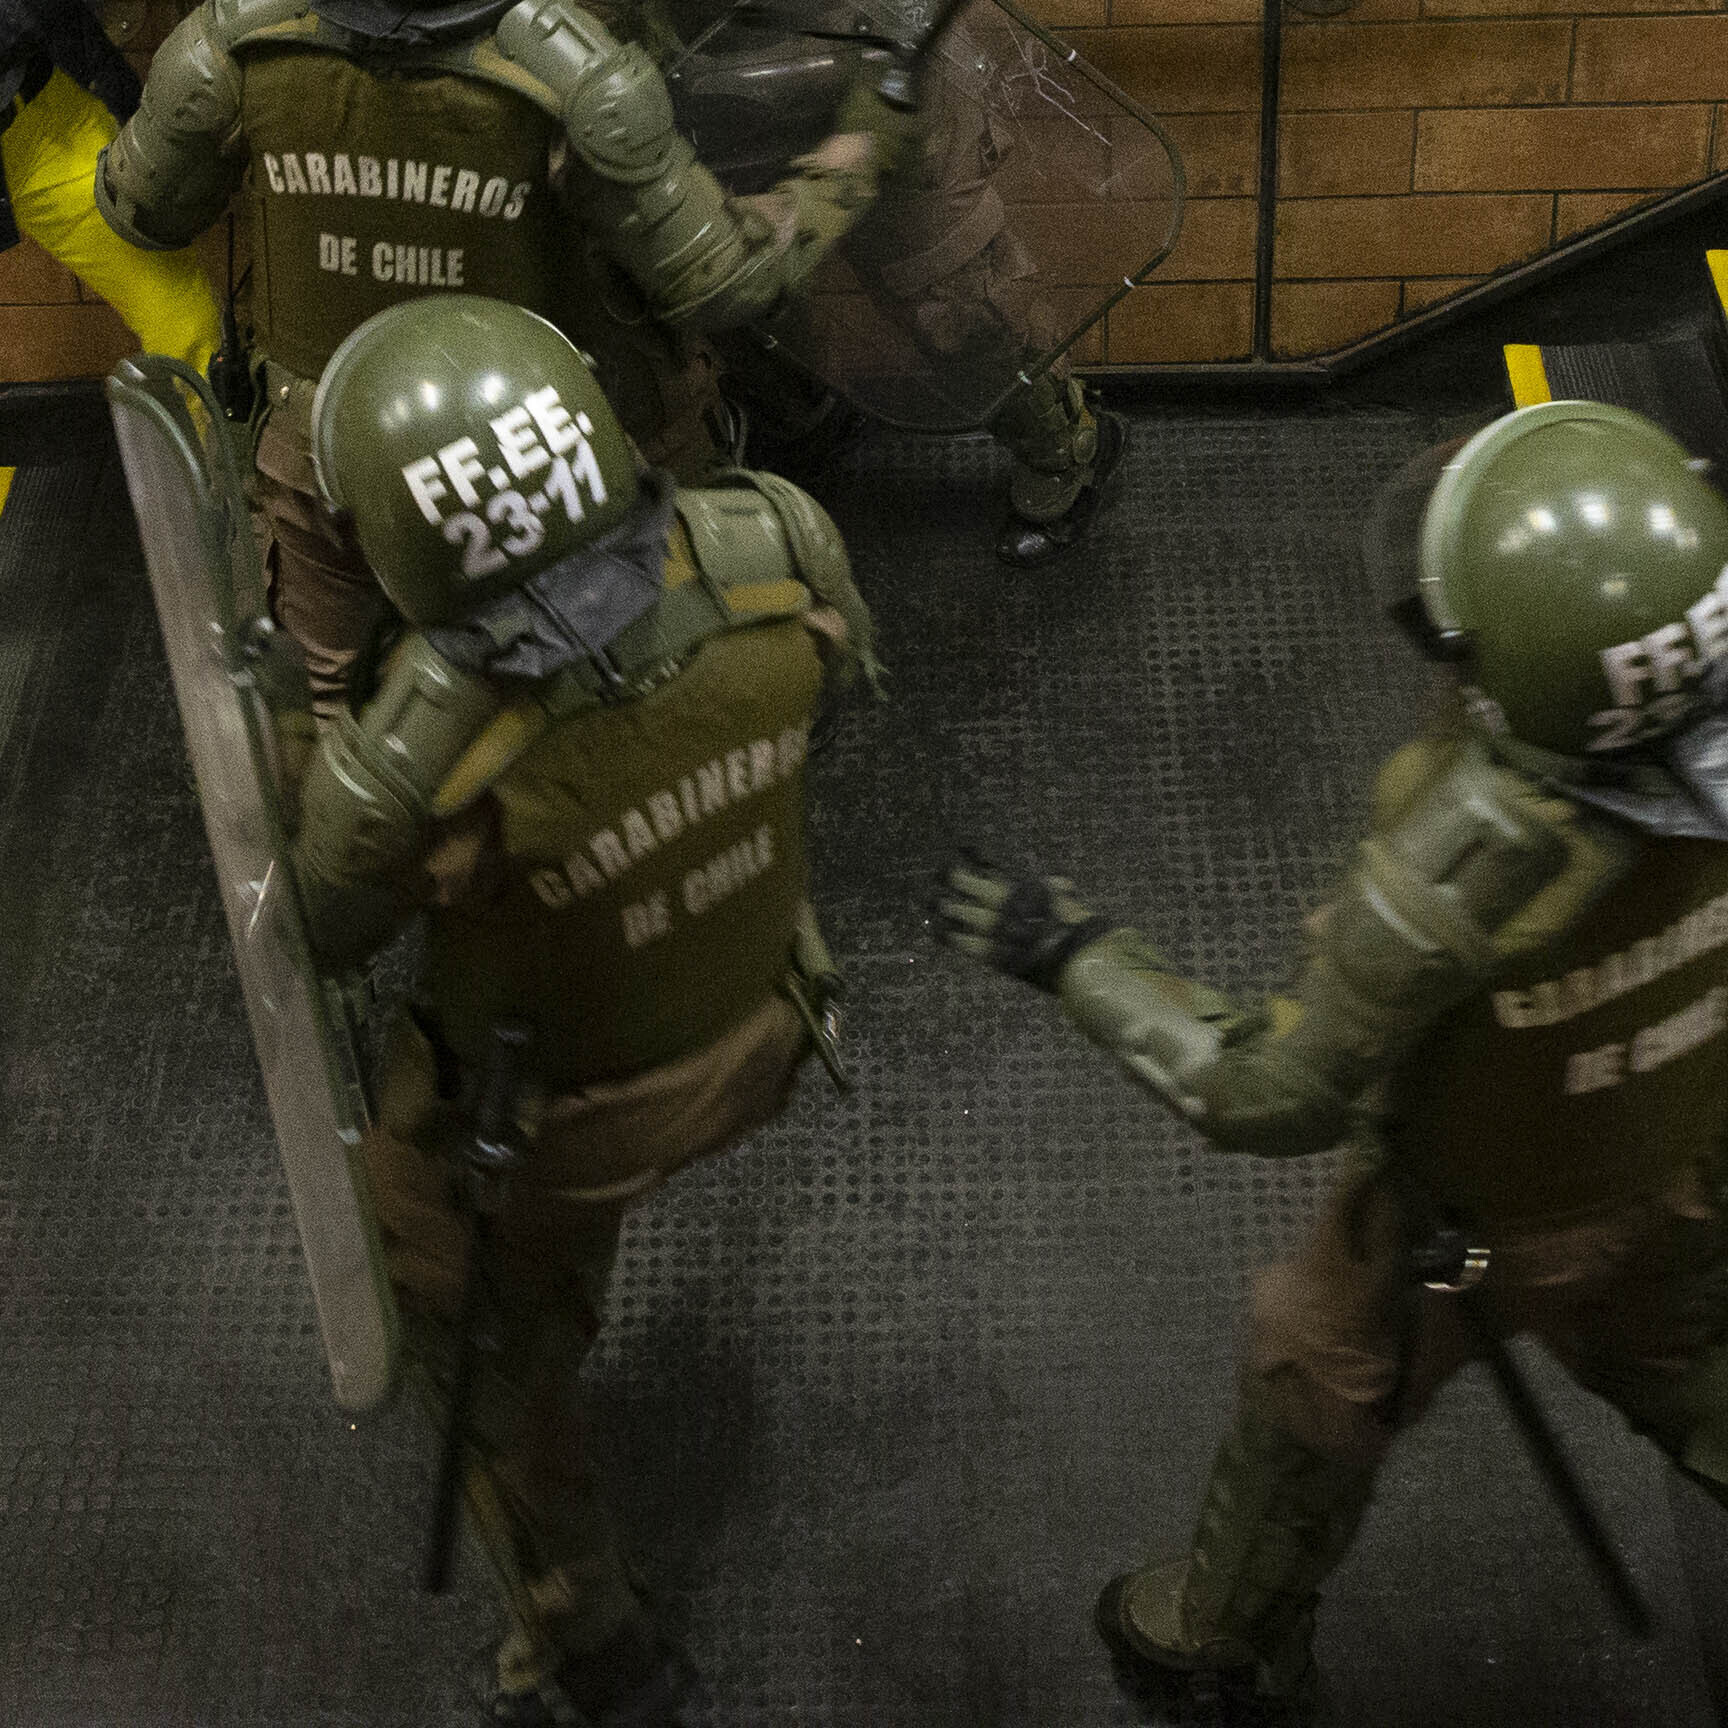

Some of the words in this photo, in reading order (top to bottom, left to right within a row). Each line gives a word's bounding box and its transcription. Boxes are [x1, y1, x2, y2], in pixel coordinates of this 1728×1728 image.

[263, 151, 531, 222] CARABINEROS
[319, 231, 358, 276] DE
[372, 241, 465, 287] CHILE
[401, 384, 596, 527] FF.EE.
